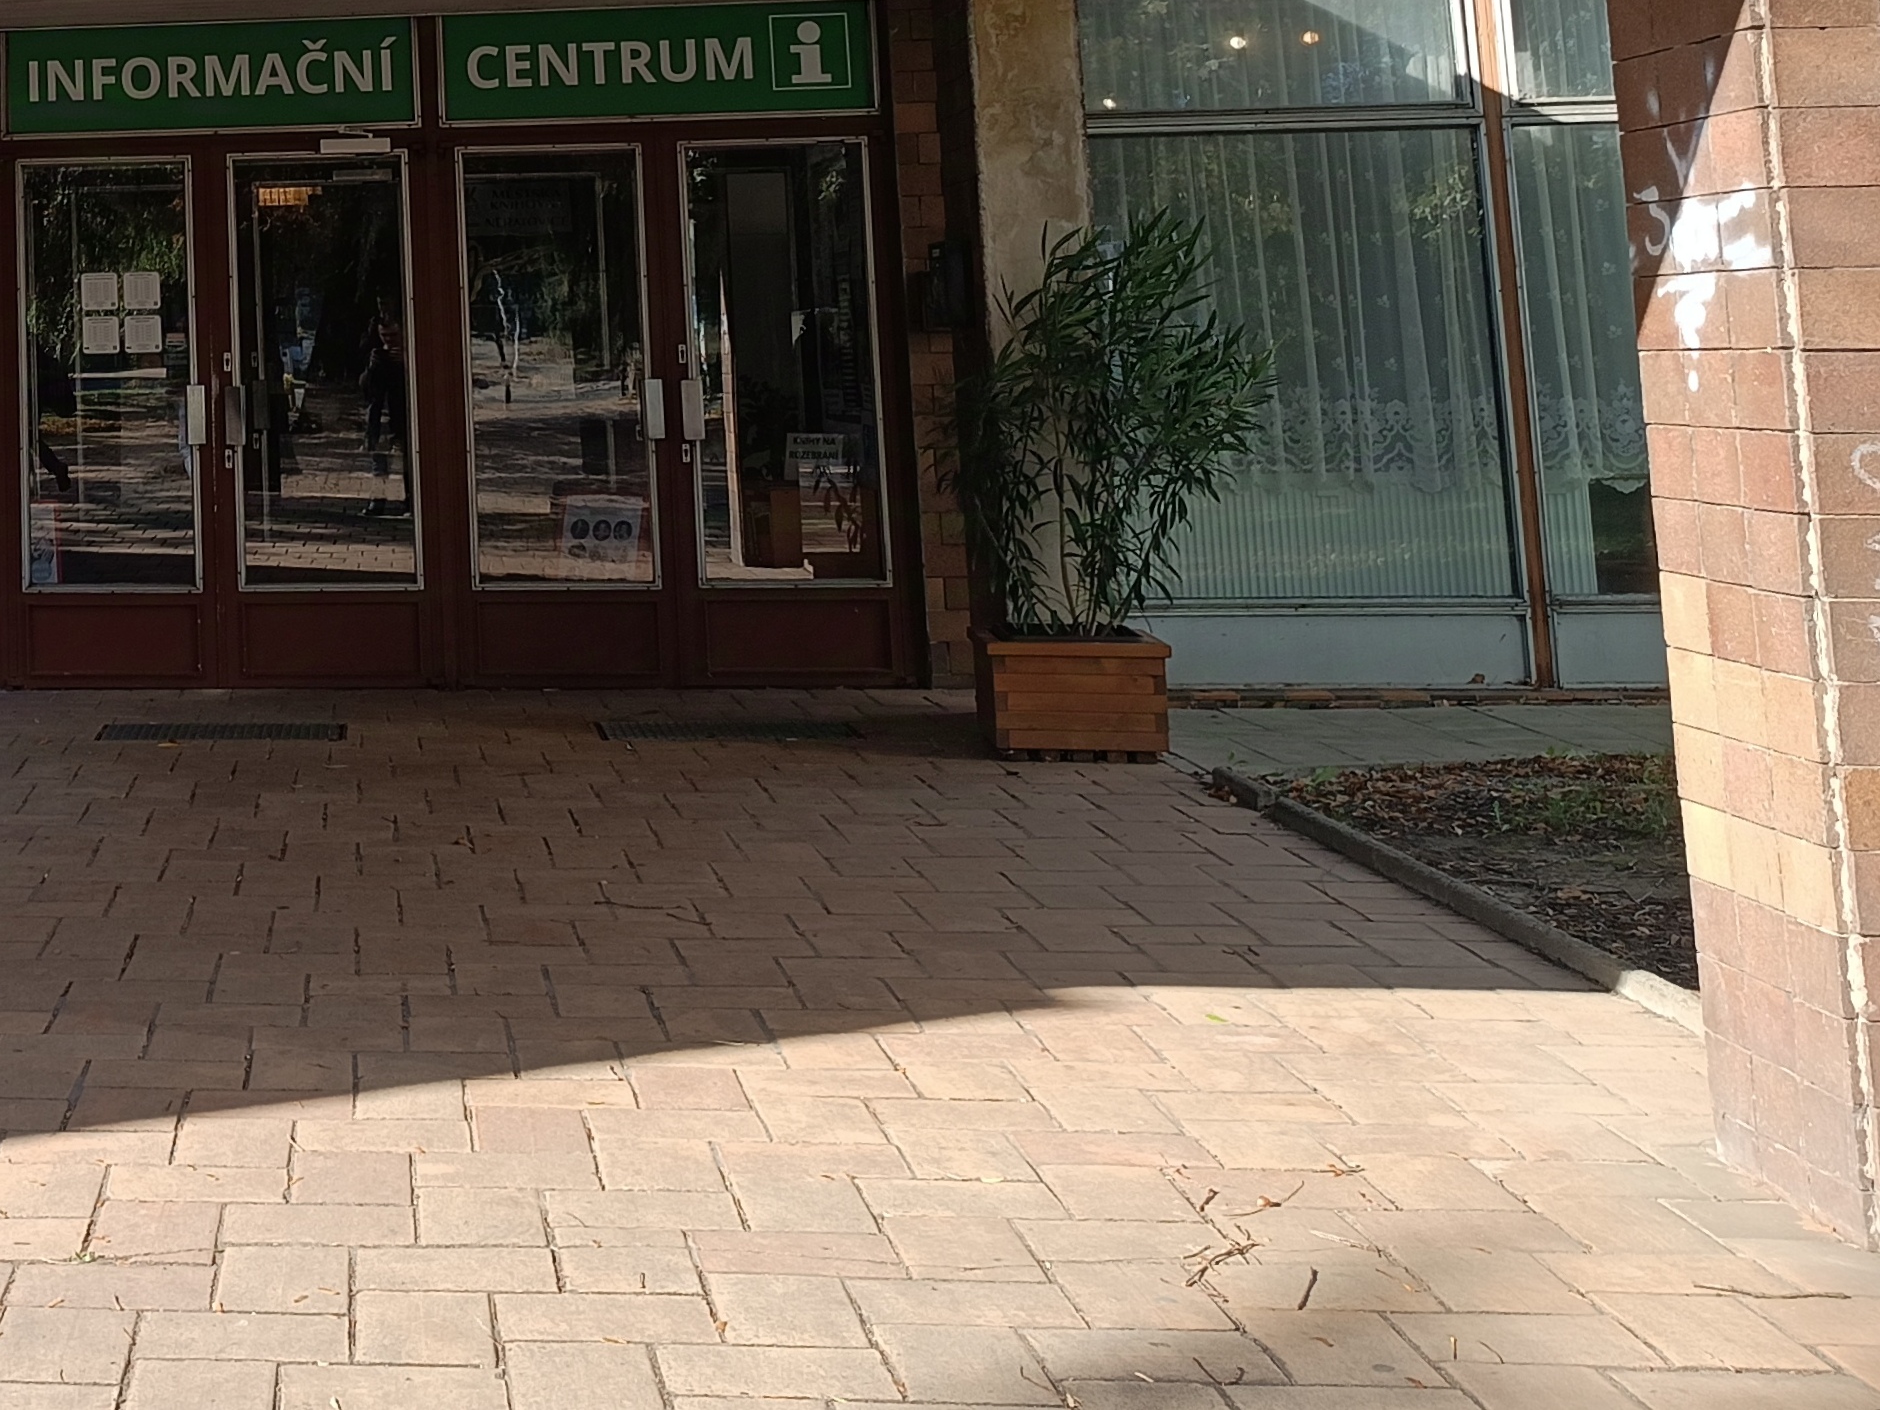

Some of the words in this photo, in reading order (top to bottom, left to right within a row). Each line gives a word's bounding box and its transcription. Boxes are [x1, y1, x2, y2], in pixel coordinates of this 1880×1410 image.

[27, 36, 398, 104] INFORMAČNÍ
[466, 36, 755, 90] CENTRUM
[490, 200, 564, 210] KNIHOV
[823, 436, 836, 445] NA
